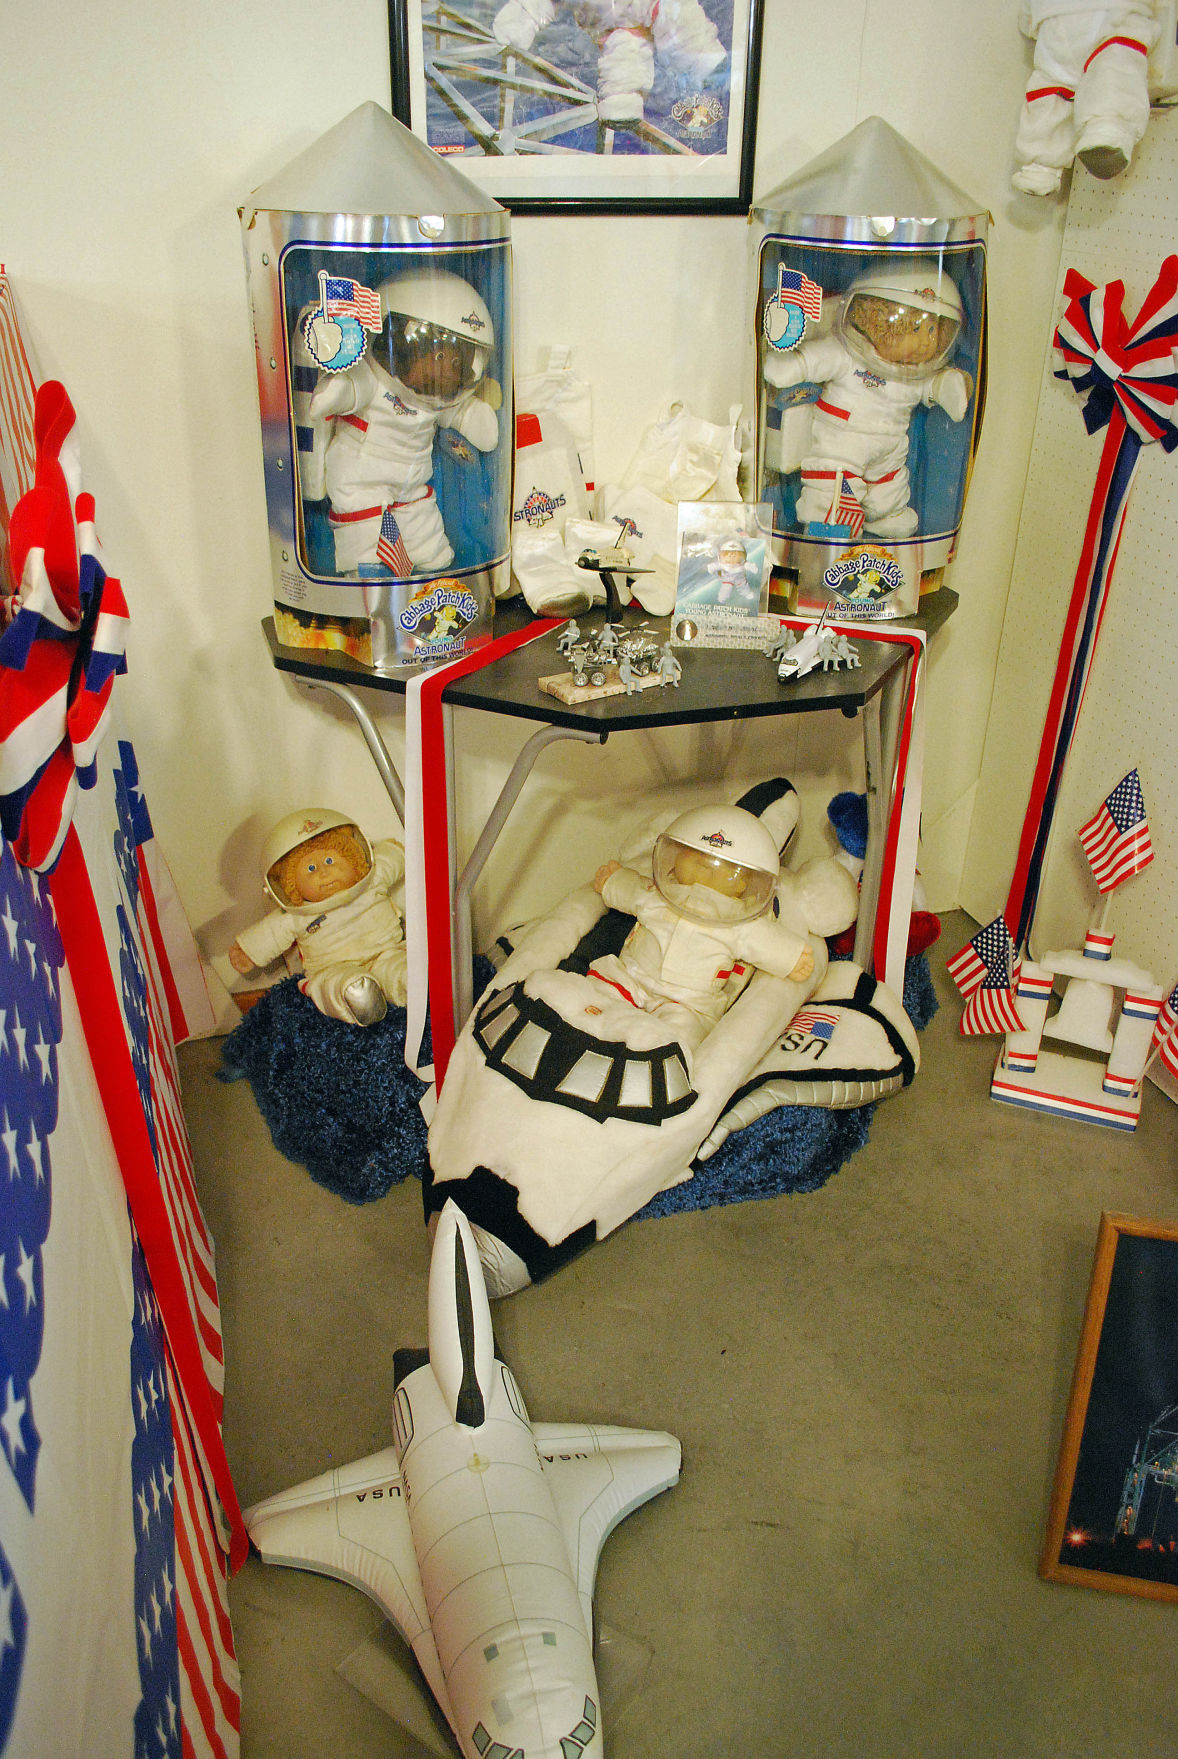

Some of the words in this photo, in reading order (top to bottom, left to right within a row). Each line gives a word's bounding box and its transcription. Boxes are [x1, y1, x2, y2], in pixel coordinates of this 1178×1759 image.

[513, 494, 566, 522] STRONAUTS
[825, 561, 861, 587] Cabbage
[860, 553, 886, 573] Patch
[400, 597, 437, 630] Cabbage
[435, 588, 461, 607] Patch
[834, 601, 888, 612] ASTRONAUT
[414, 637, 466, 656] ASTRONAUT
[431, 654, 448, 662] THIS
[780, 1032, 829, 1060] US
[543, 1452, 588, 1463] USA
[356, 1485, 401, 1503] USA
